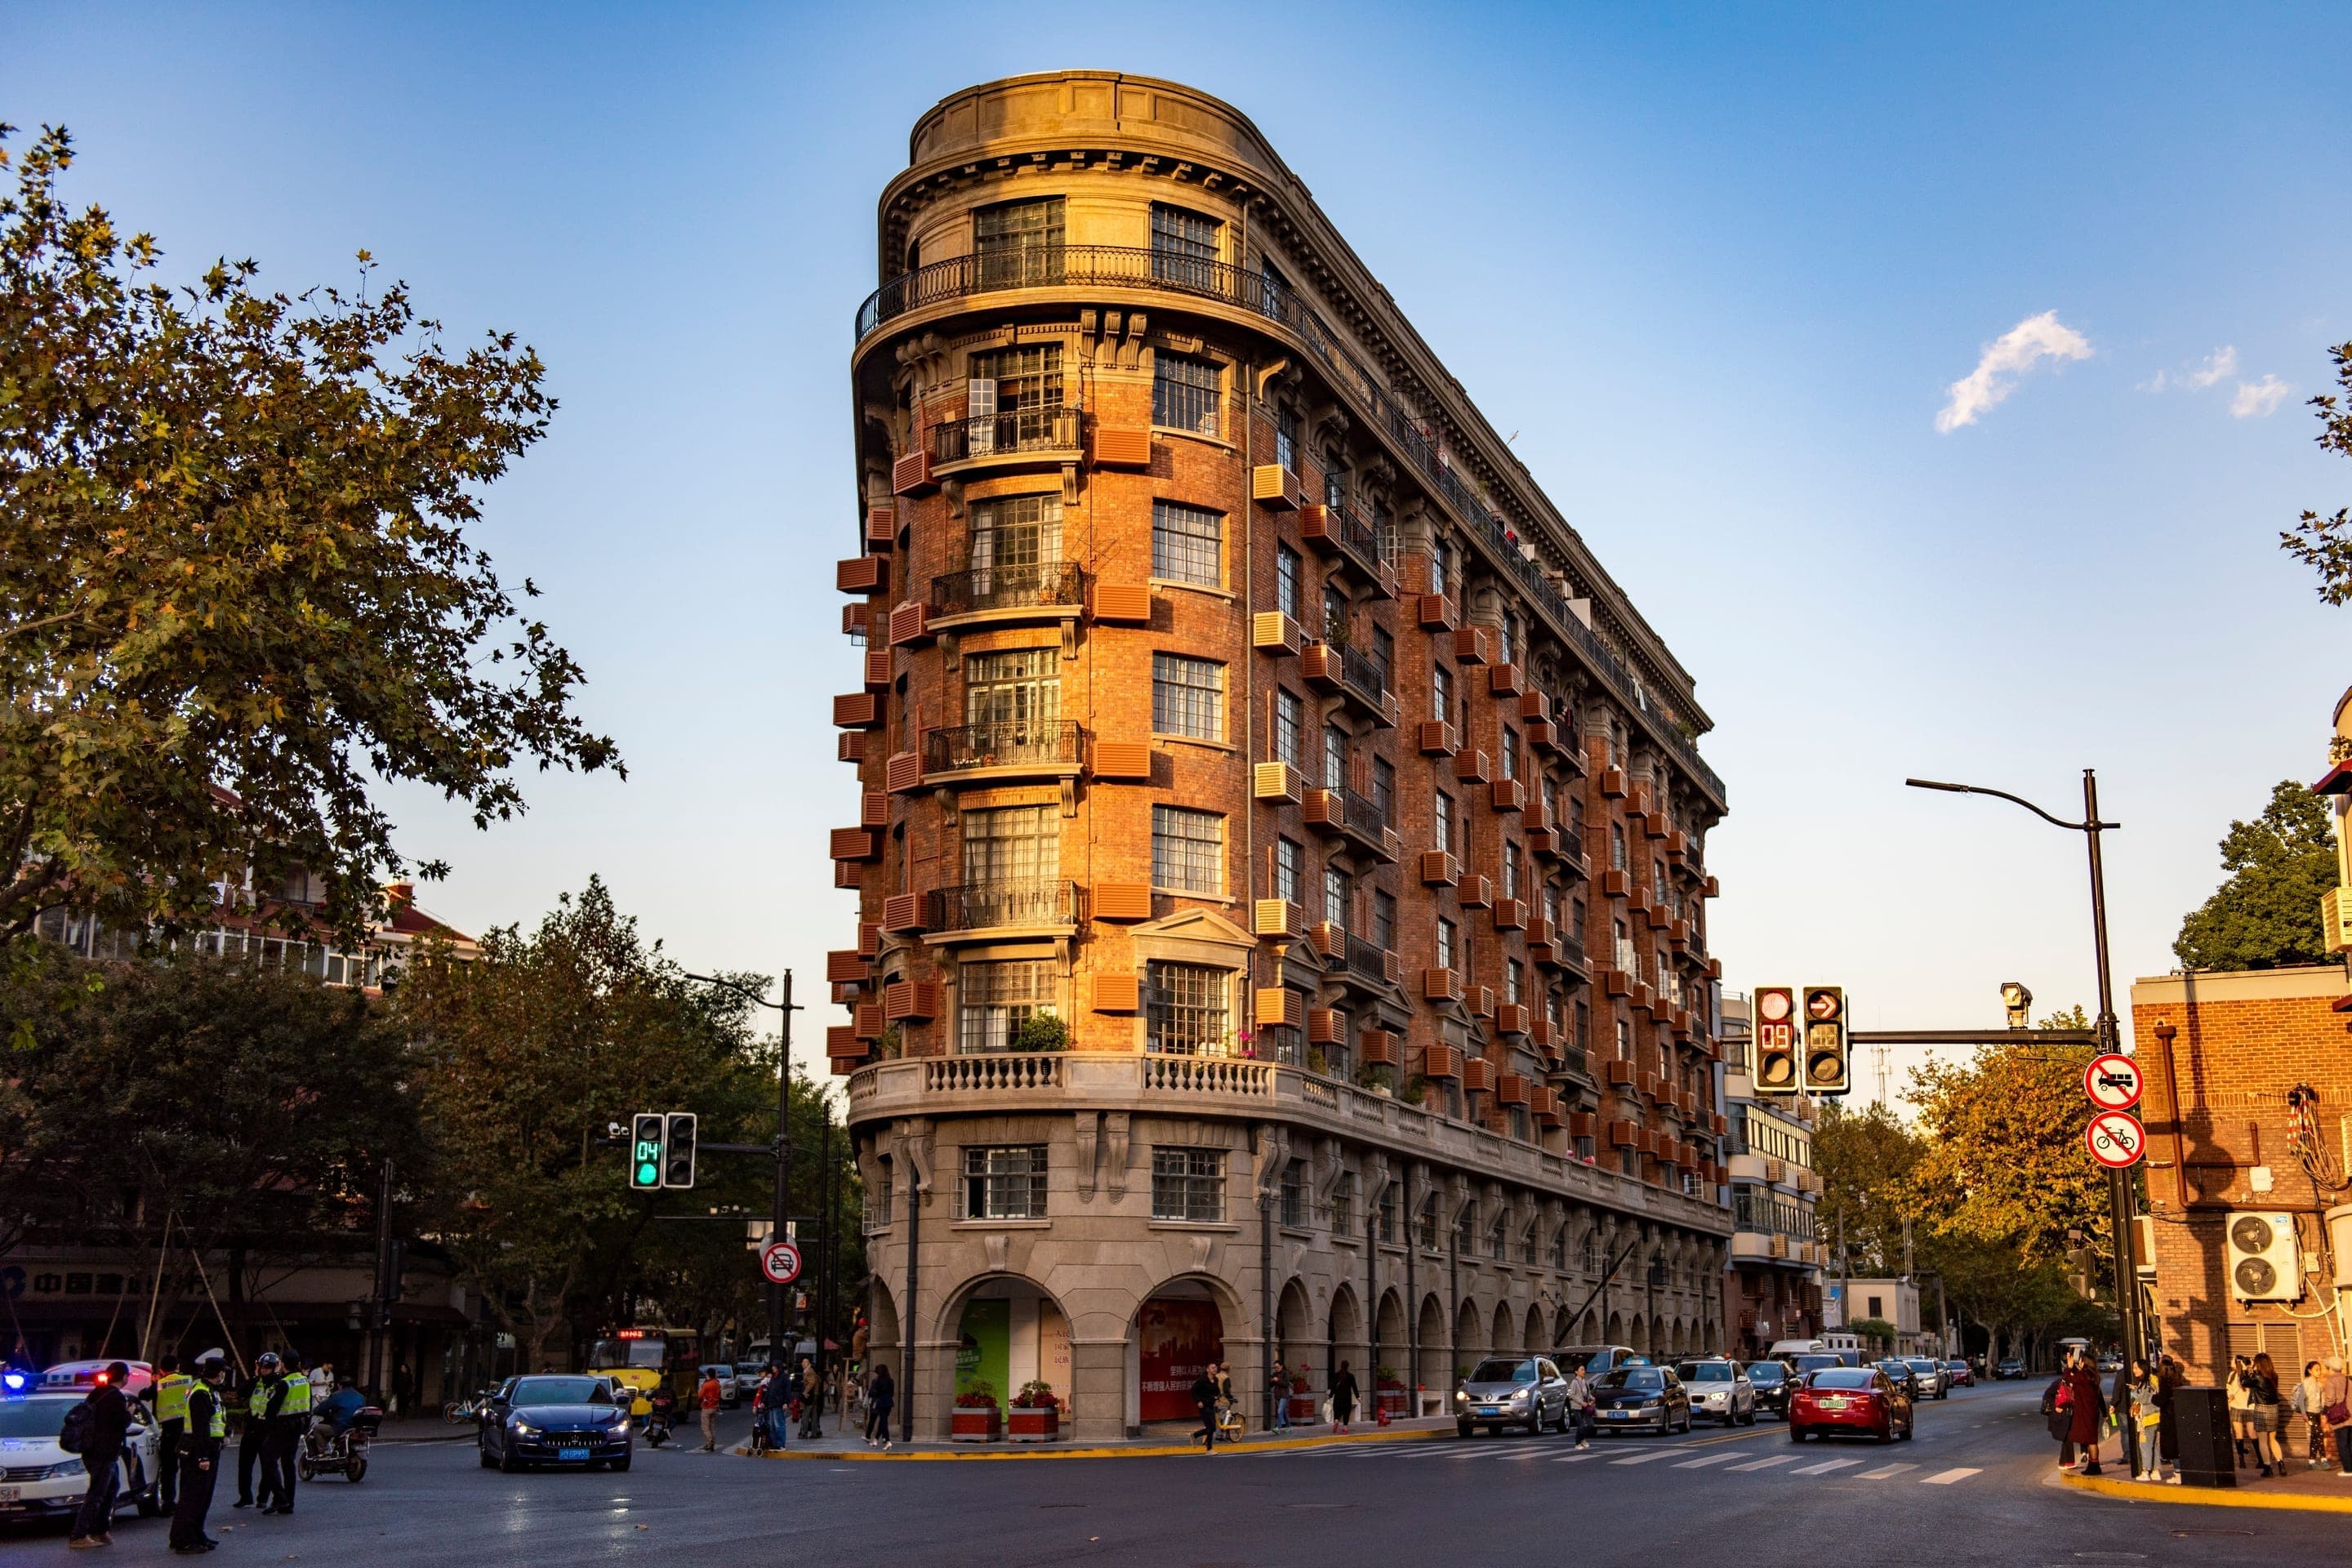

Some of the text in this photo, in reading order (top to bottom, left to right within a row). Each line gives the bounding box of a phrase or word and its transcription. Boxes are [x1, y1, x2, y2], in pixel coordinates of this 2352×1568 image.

[1762, 1024, 1788, 1048] 09
[637, 1142, 658, 1160] 04
[34, 1272, 212, 1297] 中国建行
